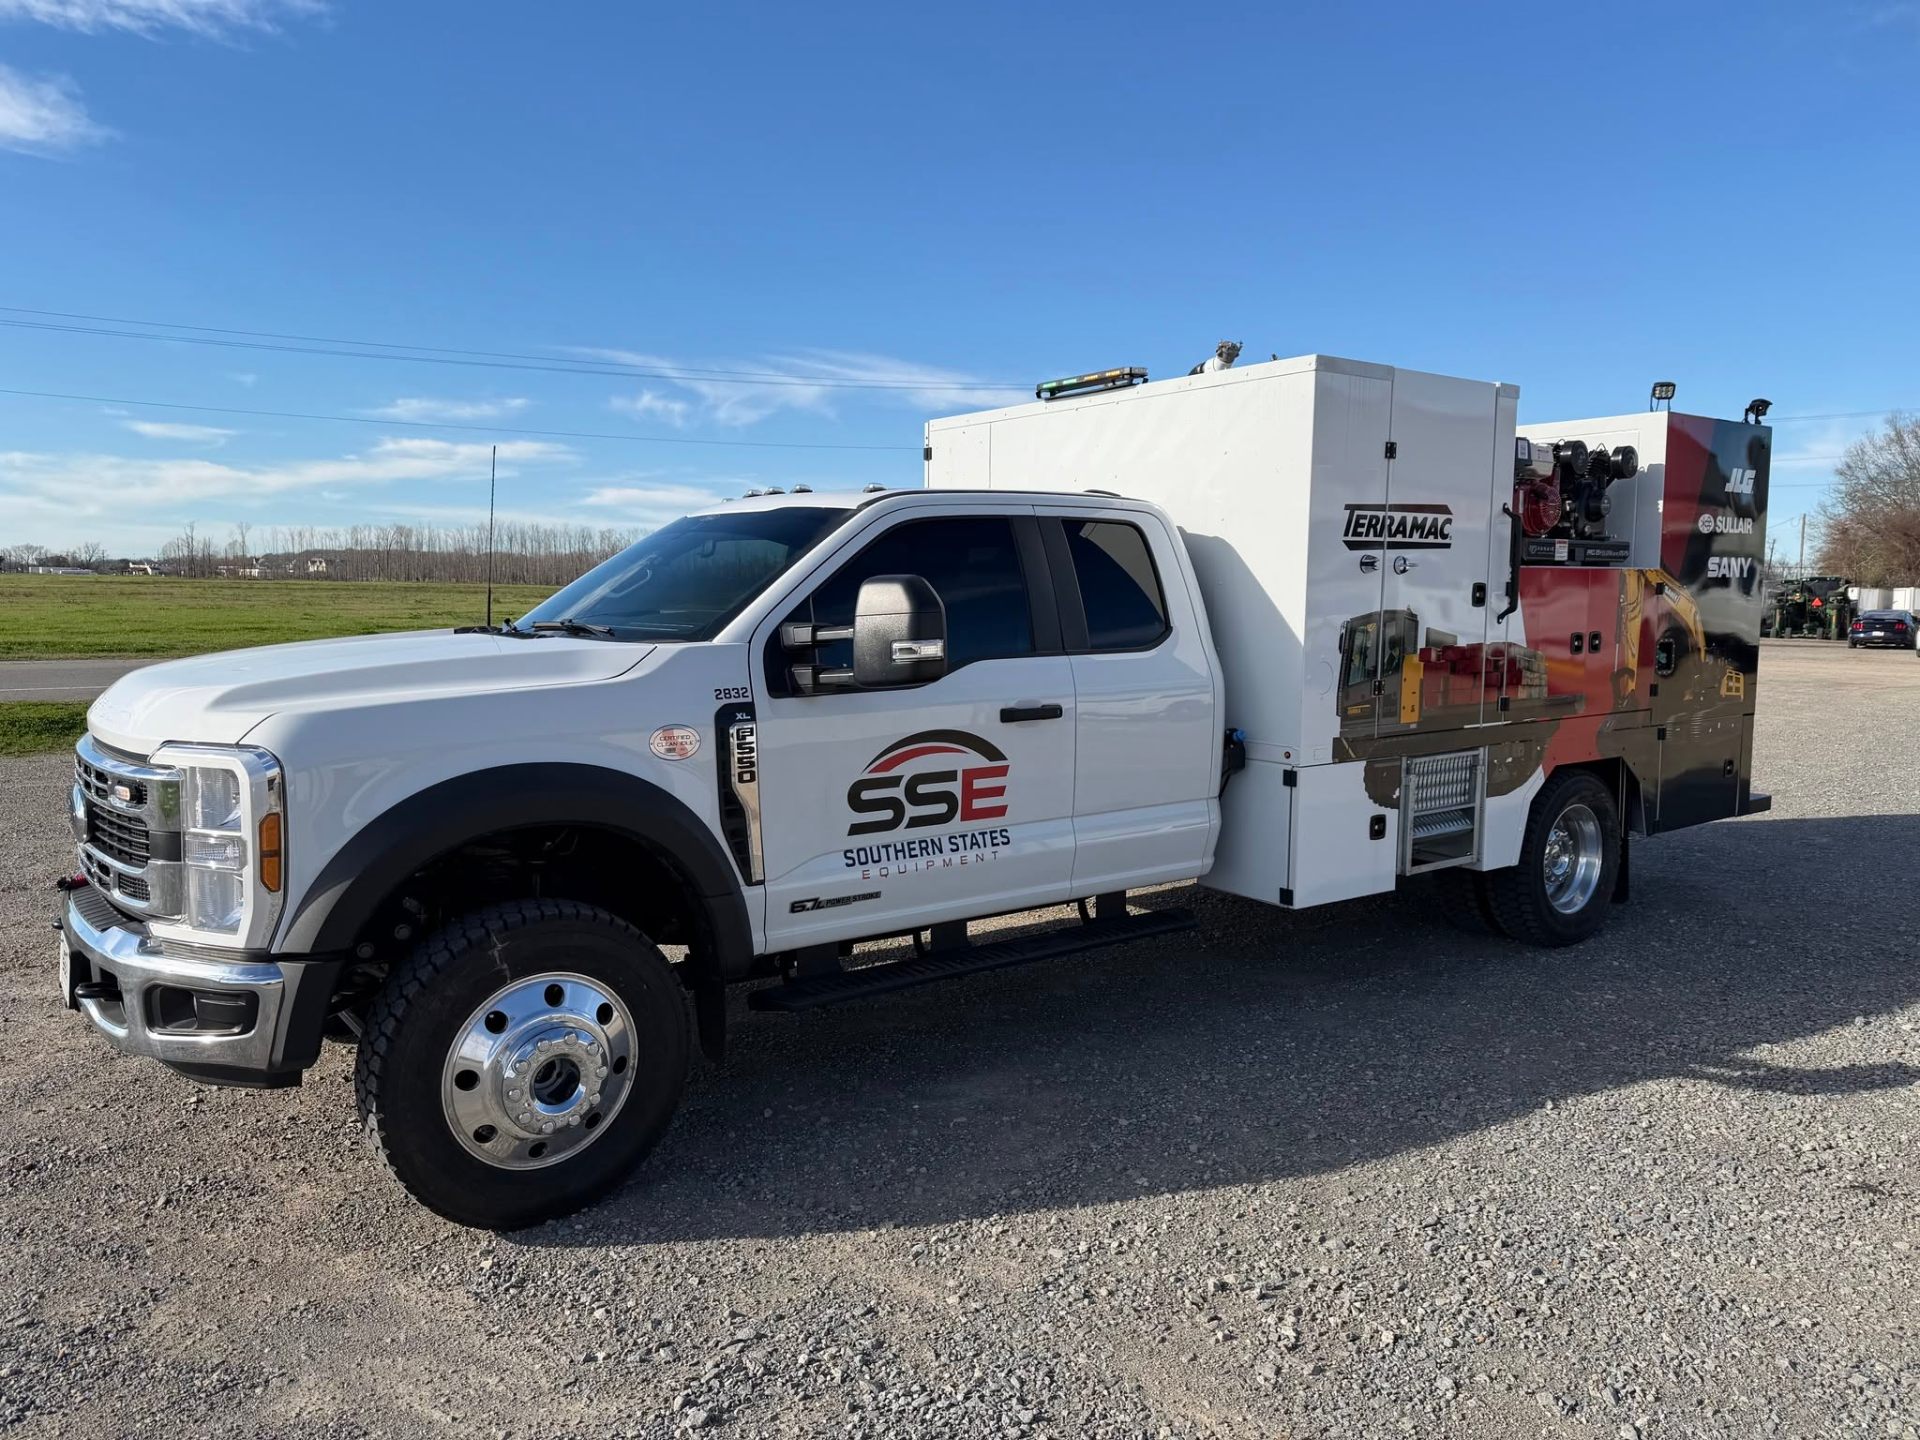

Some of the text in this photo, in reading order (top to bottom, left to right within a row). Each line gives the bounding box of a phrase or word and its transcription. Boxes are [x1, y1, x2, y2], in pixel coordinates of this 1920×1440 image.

[1724, 468, 1756, 494] JLG
[1343, 504, 1453, 540] TERRAMAC
[1715, 516, 1752, 534] SULLAIR
[1707, 556, 1753, 579] SANY
[714, 687, 749, 700] 2832
[736, 712, 751, 720] XL
[847, 765, 1010, 836] SSE
[843, 828, 1011, 868] SOUTHERN STATES
[862, 851, 999, 879] EQUIPMENT
[852, 891, 882, 902] STROKE
